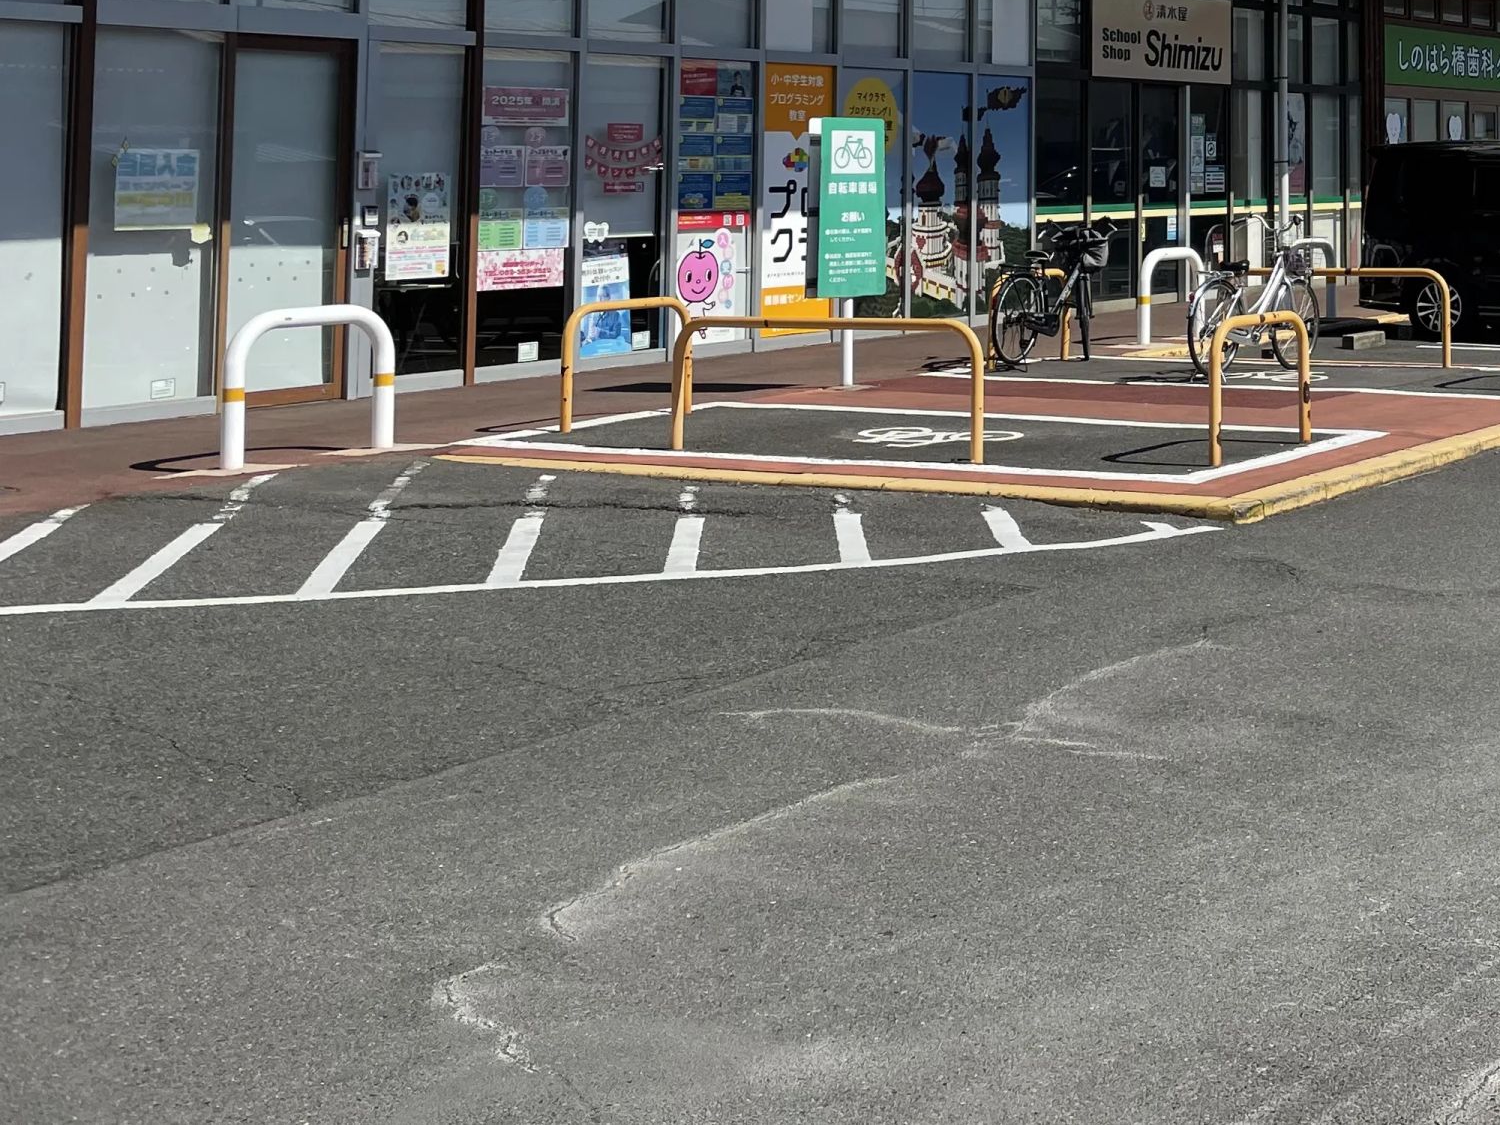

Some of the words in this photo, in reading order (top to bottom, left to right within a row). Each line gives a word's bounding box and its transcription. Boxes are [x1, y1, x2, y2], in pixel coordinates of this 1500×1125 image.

[1156, 4, 1188, 21] 清水屋
[1102, 27, 1141, 44] School
[1102, 45, 1130, 61] Shop
[1144, 29, 1222, 71] Shimizu
[771, 75, 824, 87] 小・中学生対象
[770, 93, 825, 105] プログラミング
[857, 92, 886, 102] マイクラで
[789, 109, 806, 121] 教室
[828, 181, 877, 194] 自転車置場
[841, 211, 865, 223] お願い
